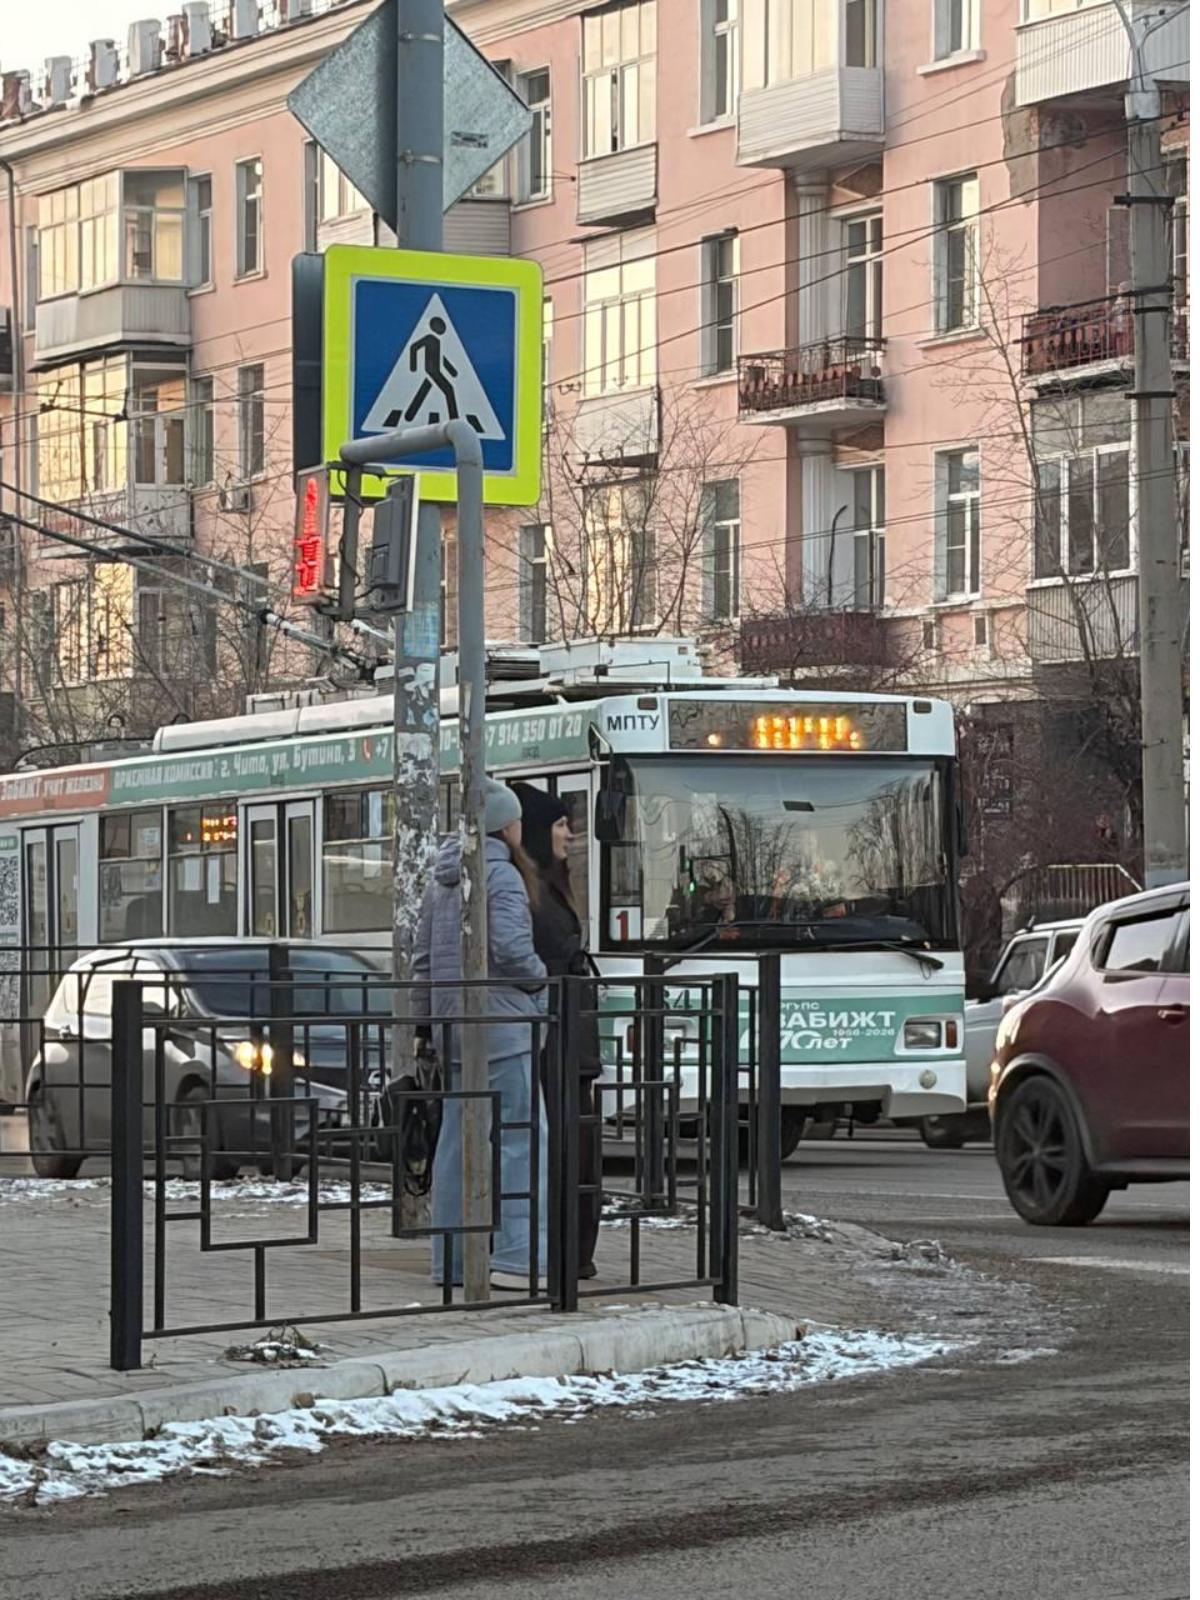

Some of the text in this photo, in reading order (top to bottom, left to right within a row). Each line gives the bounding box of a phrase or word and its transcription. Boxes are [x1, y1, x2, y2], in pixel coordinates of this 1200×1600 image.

[607, 714, 660, 731] МПТУ
[233, 753, 269, 776] Чита,
[272, 752, 290, 775] ул.
[499, 721, 519, 746] 914
[522, 719, 545, 743] 350
[550, 716, 562, 739] 01
[565, 714, 582, 737] 20
